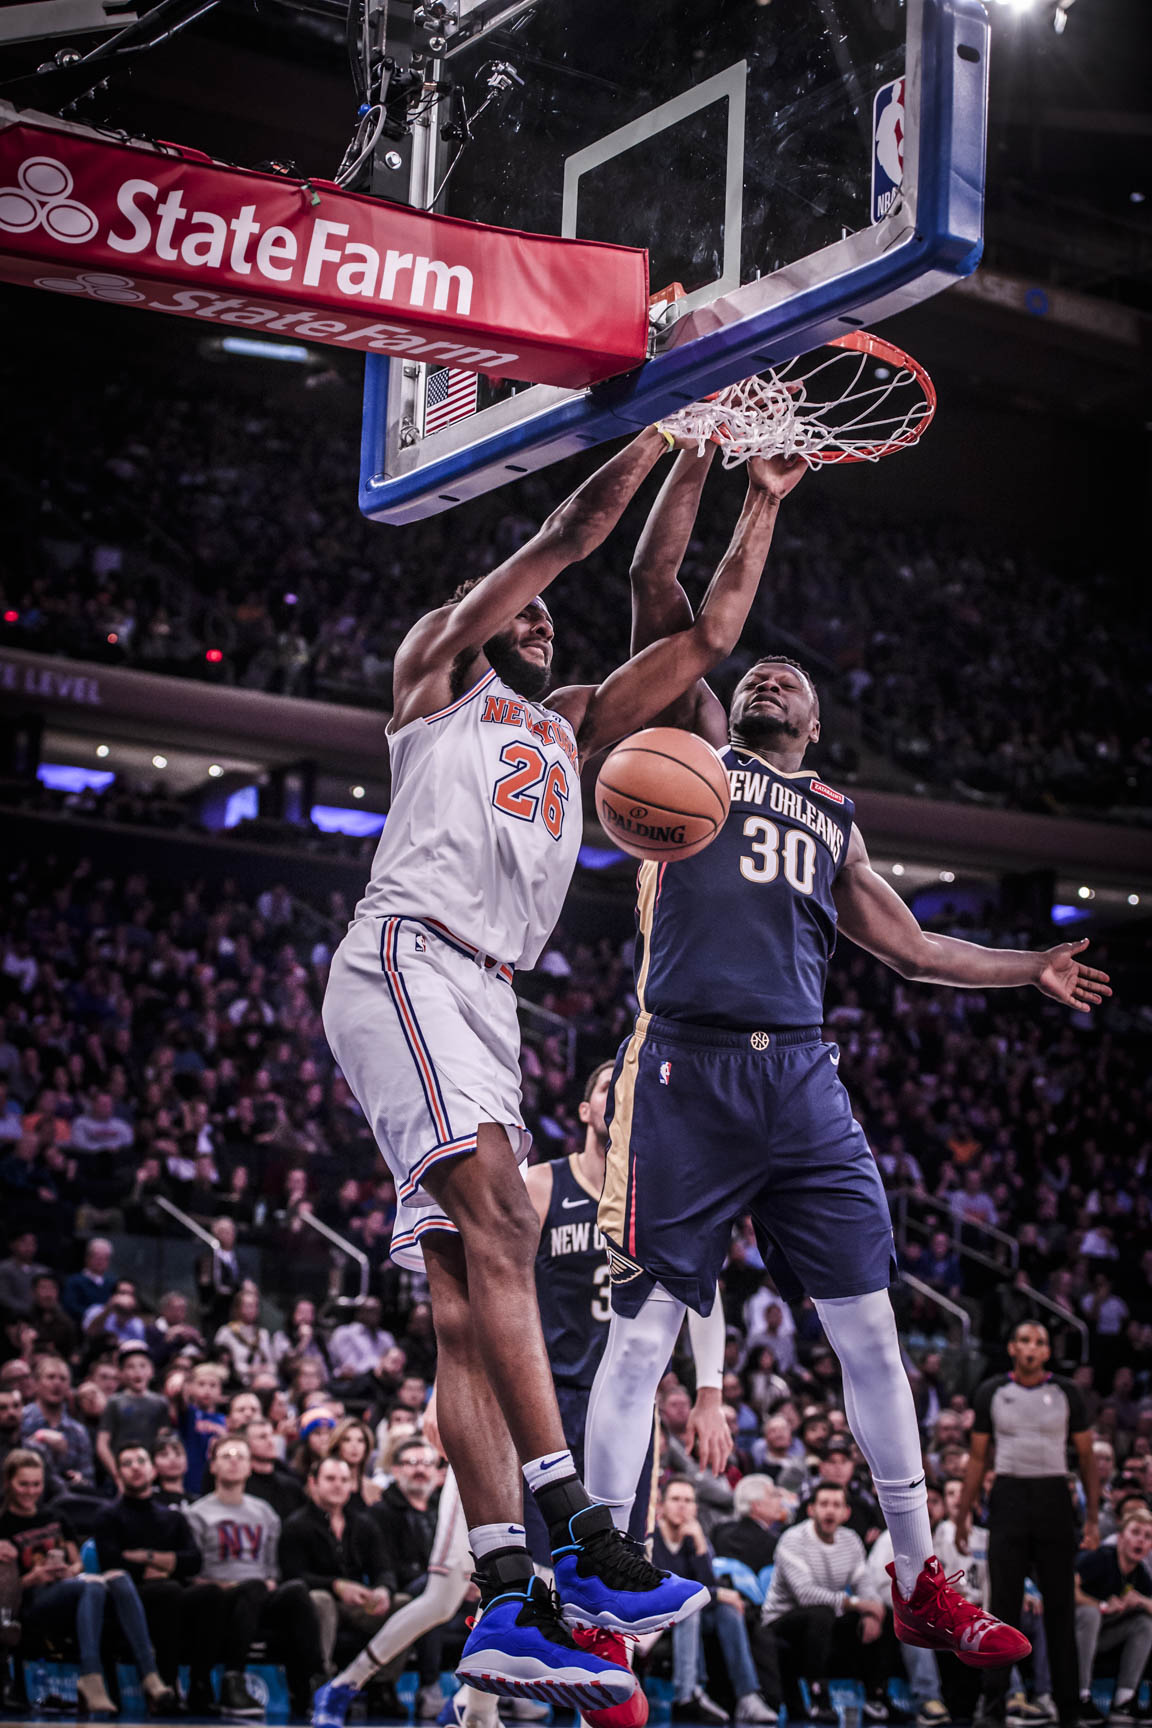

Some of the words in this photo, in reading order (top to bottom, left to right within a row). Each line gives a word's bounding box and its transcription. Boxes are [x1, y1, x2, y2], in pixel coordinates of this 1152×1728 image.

[24, 667, 102, 706] LEVEL
[492, 739, 569, 841] 26
[770, 782, 844, 864] ORLEANS
[740, 815, 817, 896] 30
[550, 1222, 591, 1258] NEW
[218, 1524, 263, 1561] NY
